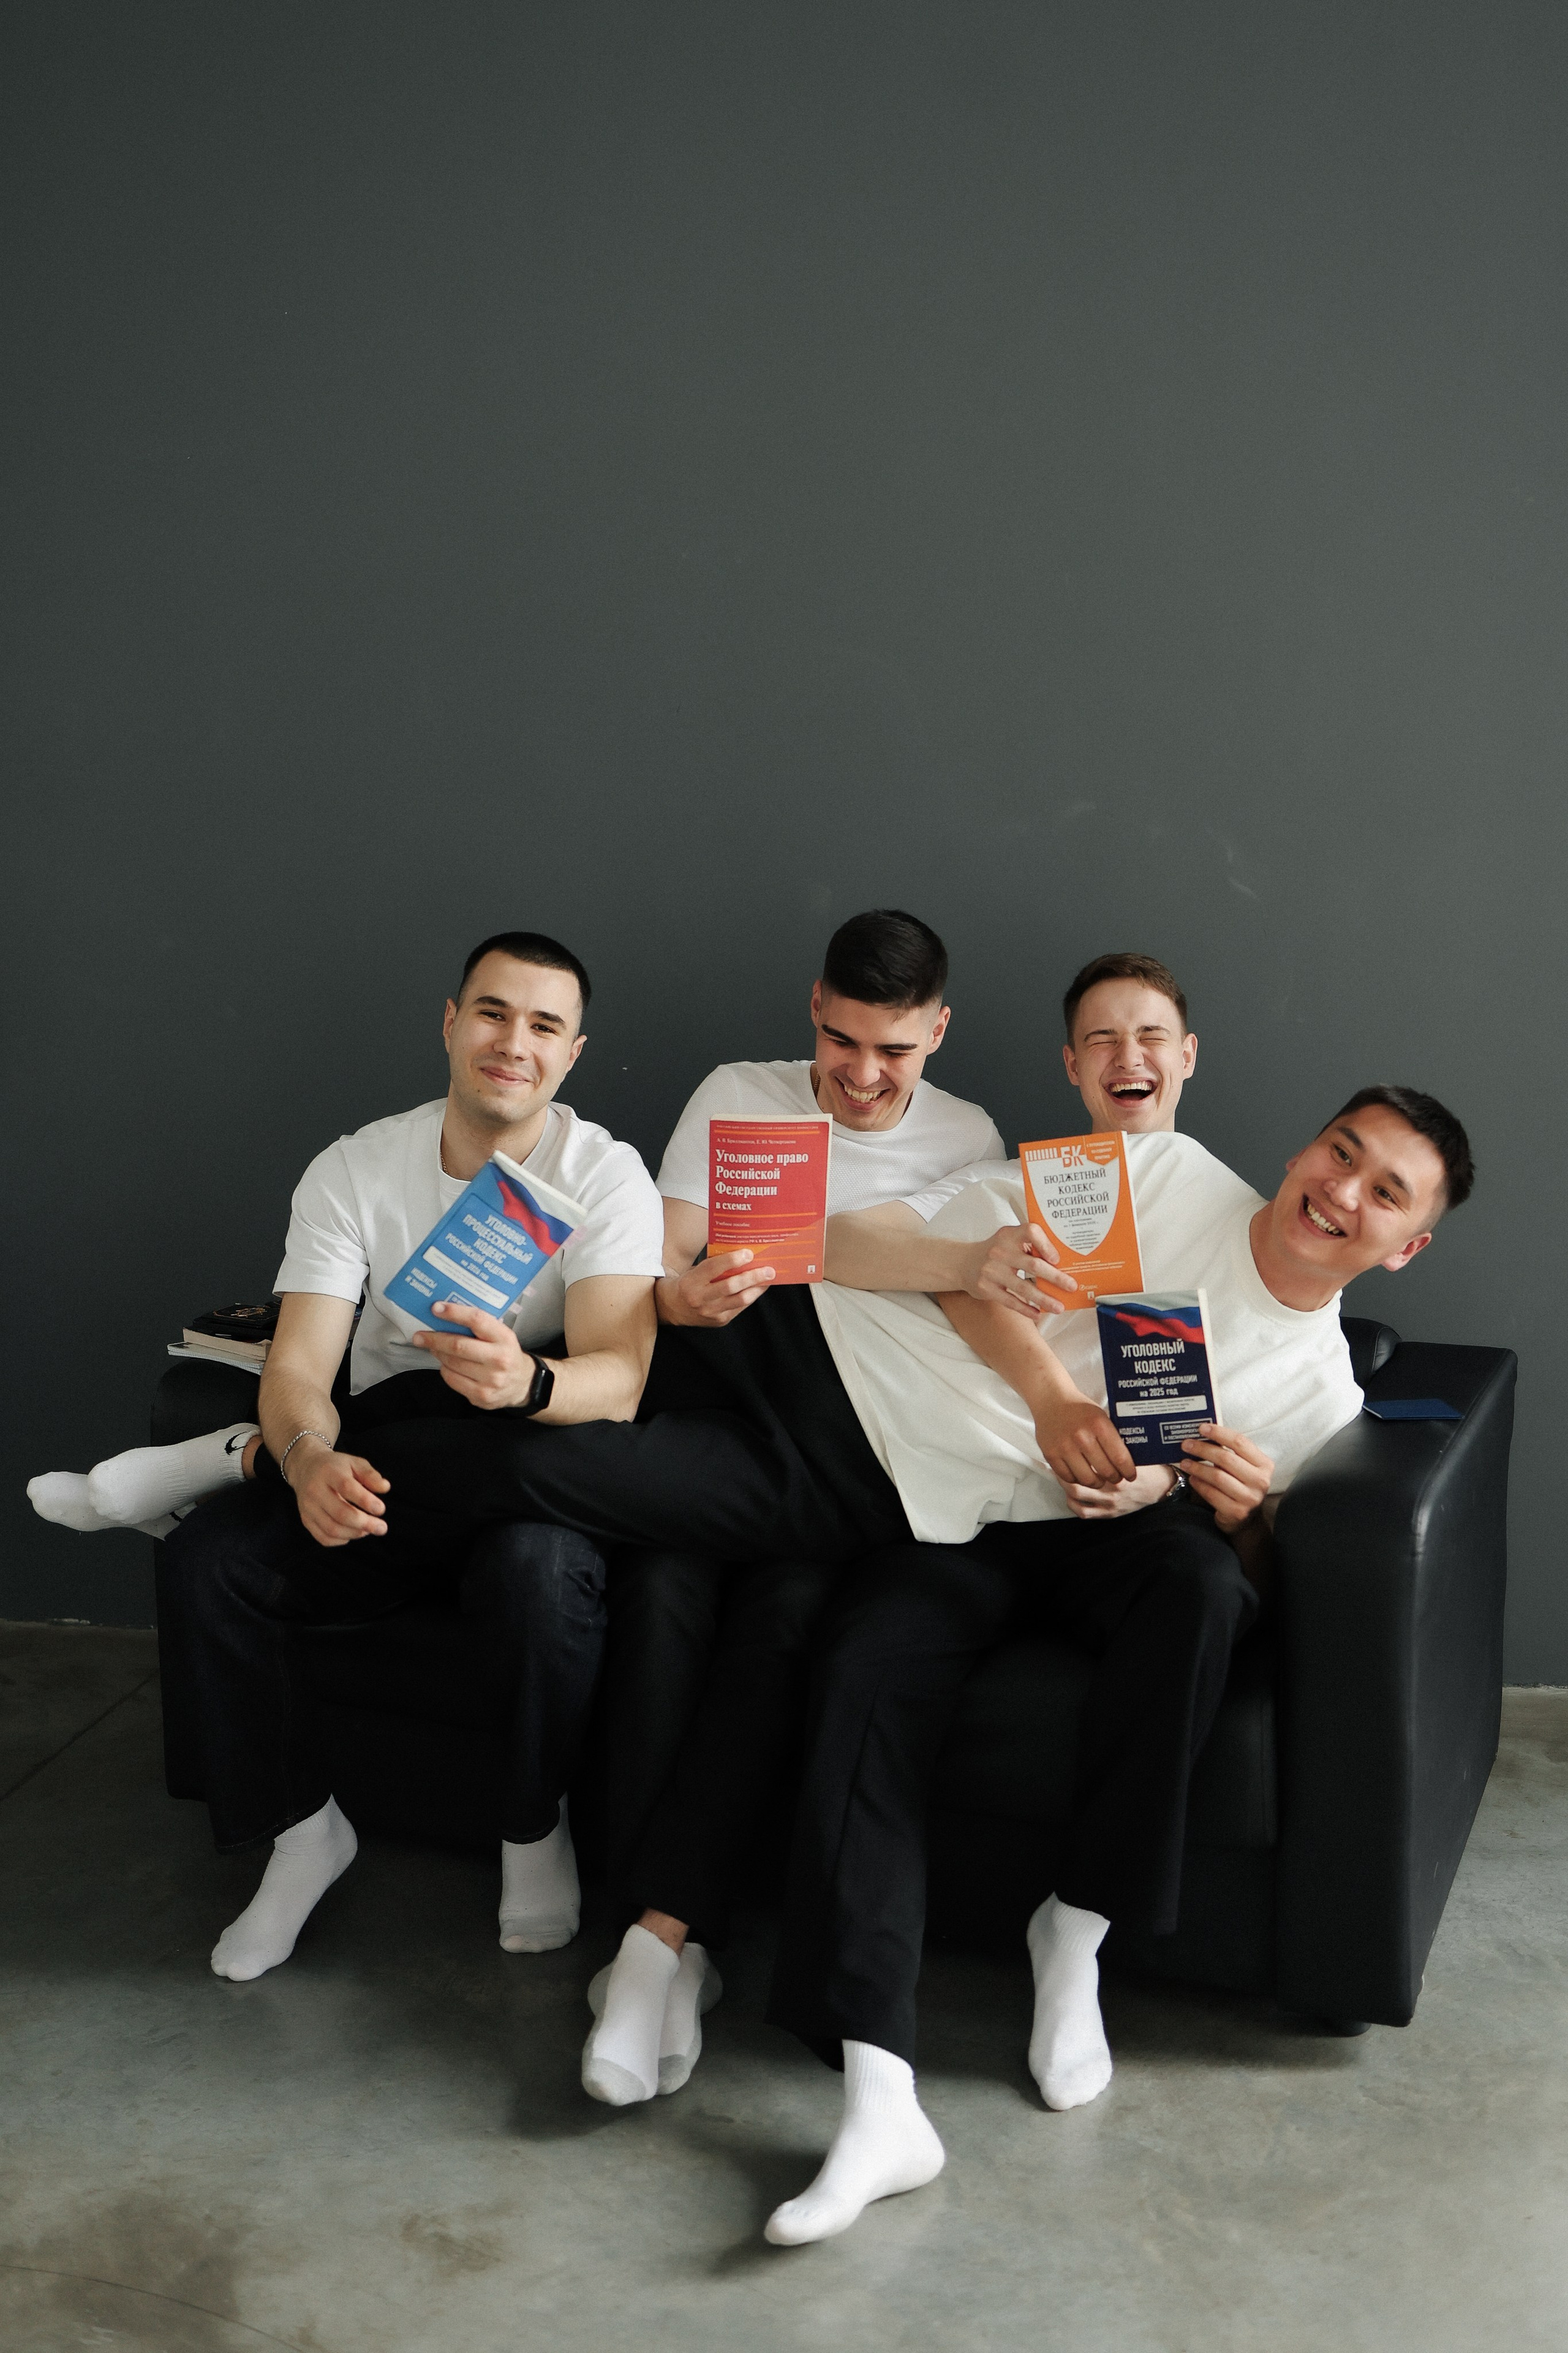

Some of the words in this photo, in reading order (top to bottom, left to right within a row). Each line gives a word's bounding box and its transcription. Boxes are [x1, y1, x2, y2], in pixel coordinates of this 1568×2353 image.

[715, 1149, 774, 1164] Уголовное
[777, 1154, 809, 1166] право
[715, 1165, 781, 1180] Российской
[1044, 1168, 1106, 1184] БЮДЖЕТНЫЙ
[715, 1181, 778, 1198] Федерации
[1058, 1182, 1095, 1195] КОДЕКС
[722, 1202, 752, 1210] схемах
[1047, 1191, 1109, 1208] РОССИЙСКОЙ
[1052, 1205, 1107, 1219] ФЕДЕРАЦИИ
[462, 1214, 533, 1264] ПРОЦЕССУАЛЬНЫЙ
[445, 1233, 486, 1265] РОССИЙСКОЙ
[473, 1238, 507, 1264] КОДЕКС
[1120, 1338, 1185, 1358] УГОЛОВНЫЙ
[1134, 1358, 1177, 1375] КОДЕКС
[1118, 1377, 1159, 1388] РОССИЙСКОЙ
[1159, 1374, 1197, 1386] ФЕДЕРАЦИИ
[1148, 1387, 1165, 1397] 2025
